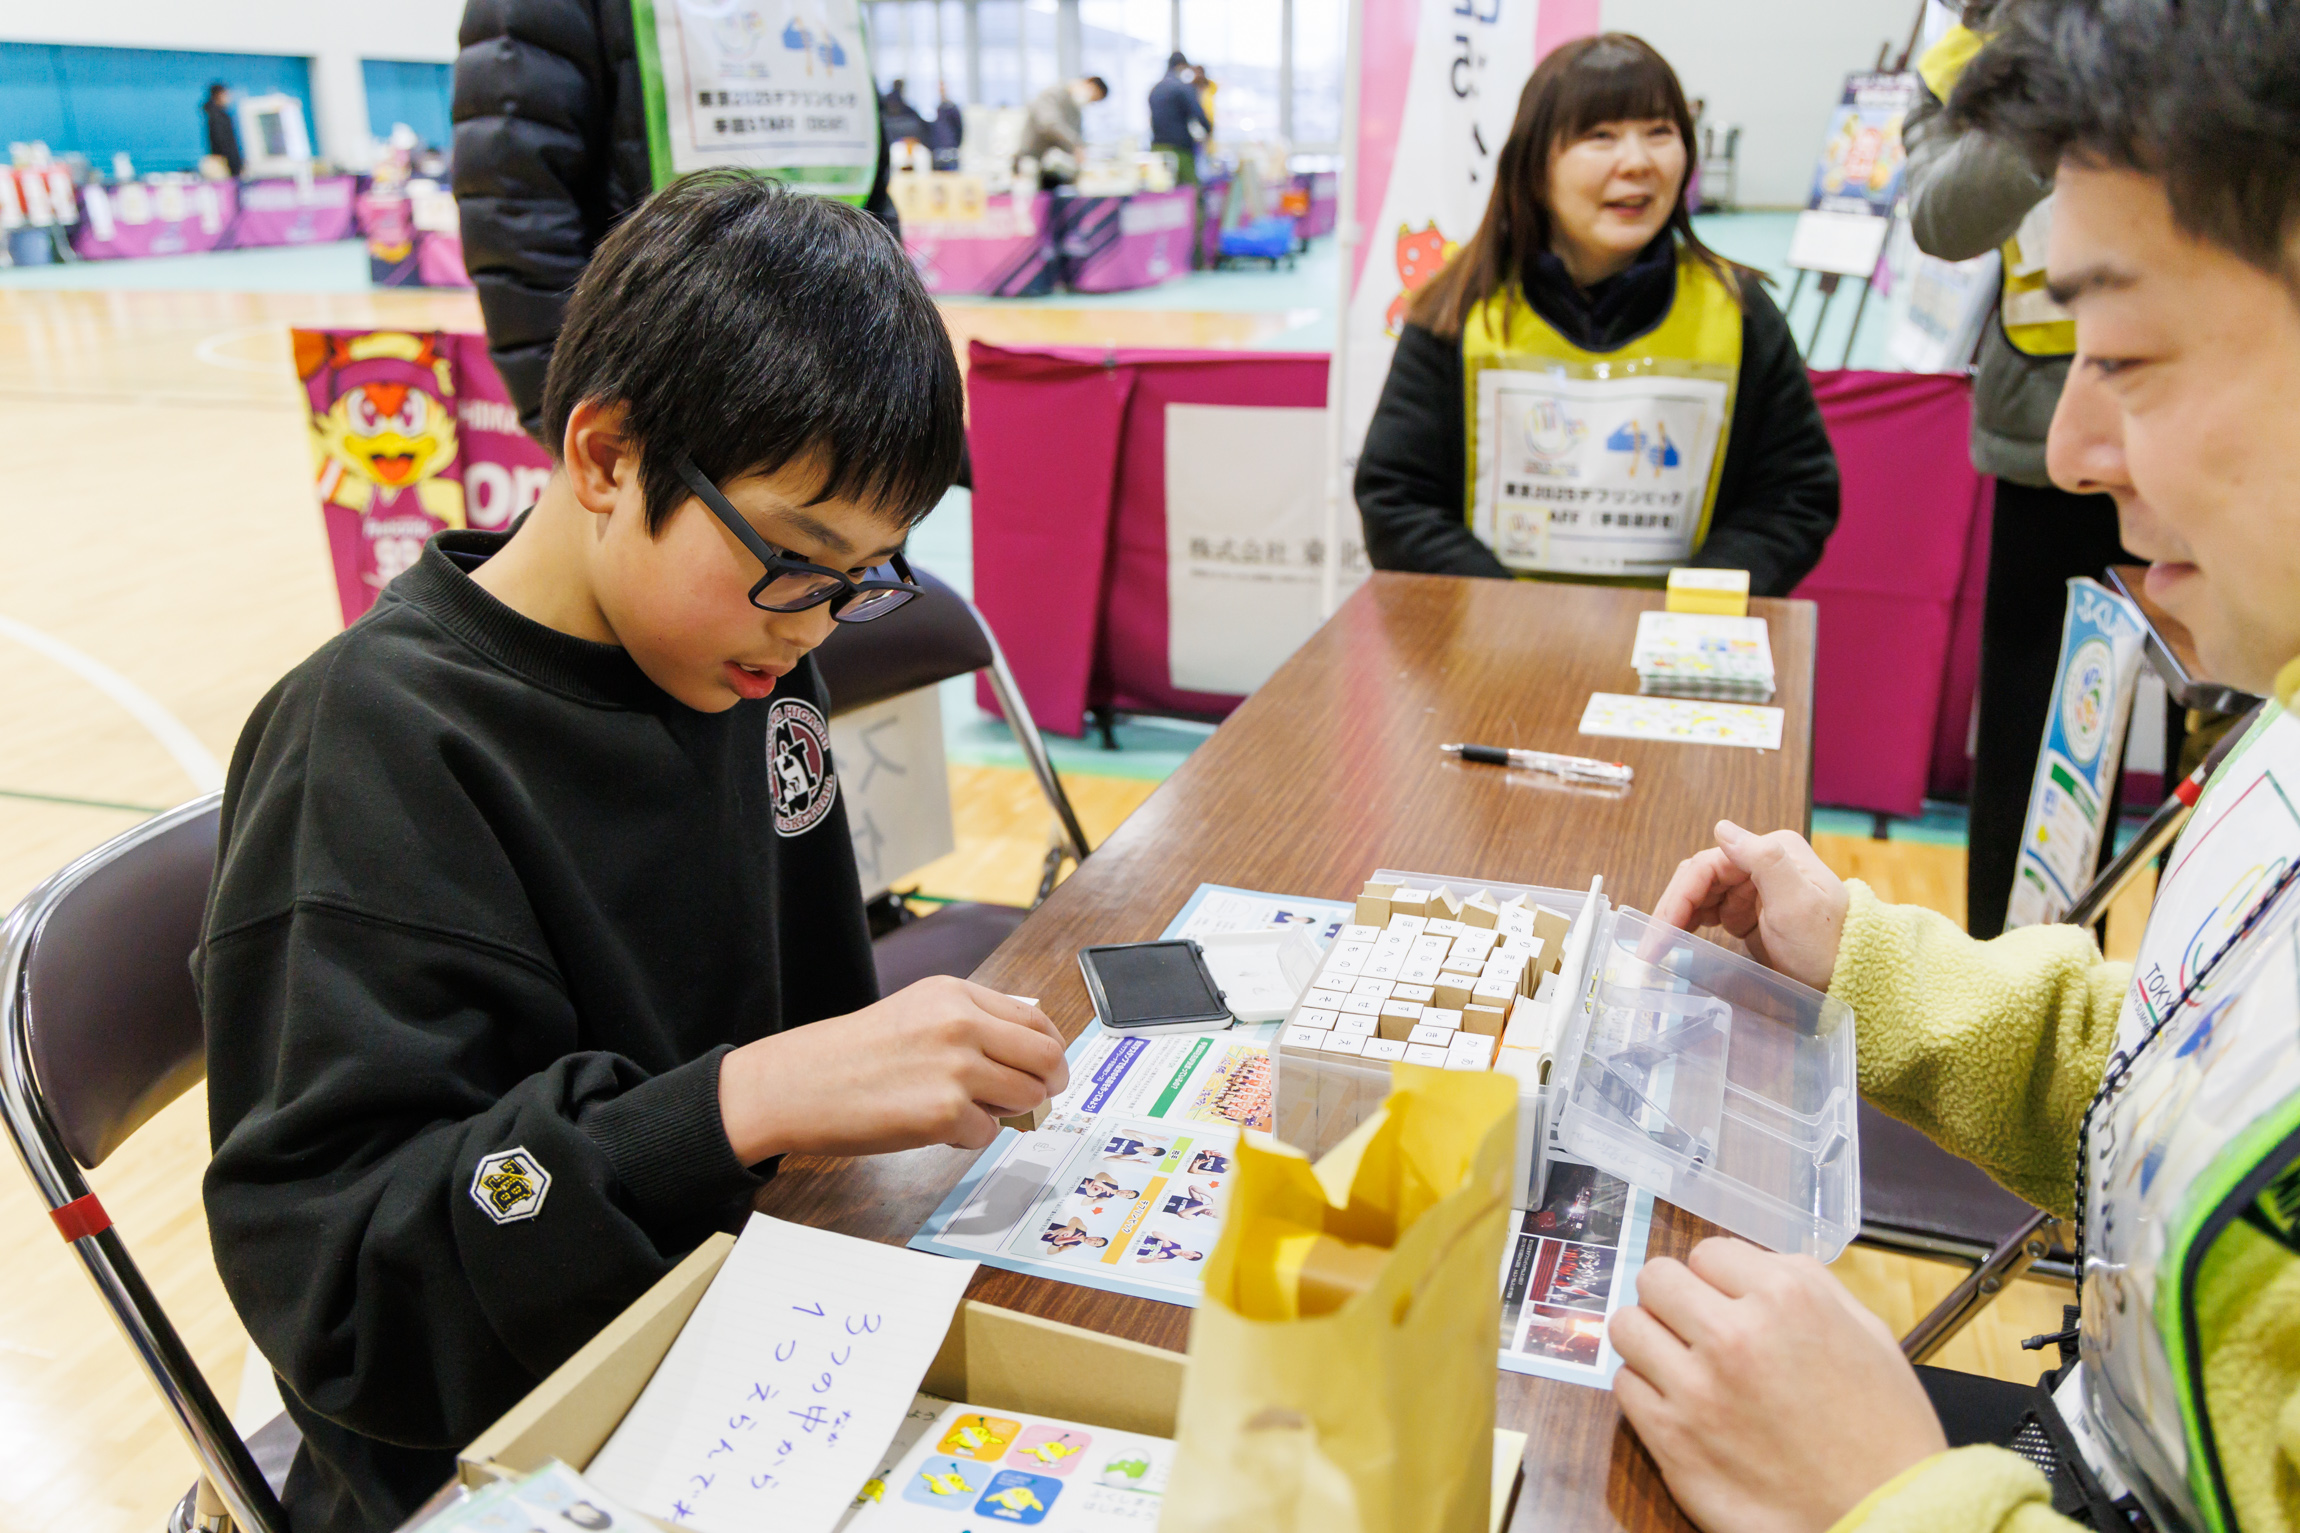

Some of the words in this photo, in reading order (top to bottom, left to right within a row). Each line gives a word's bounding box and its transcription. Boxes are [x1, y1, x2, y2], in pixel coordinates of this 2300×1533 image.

[1189, 537, 1289, 565] 株式会社
[2144, 962, 2177, 1013] TOKY
[1121, 1200, 1149, 1234] デフリンピック
[750, 1313, 882, 1490] 3つの中から
